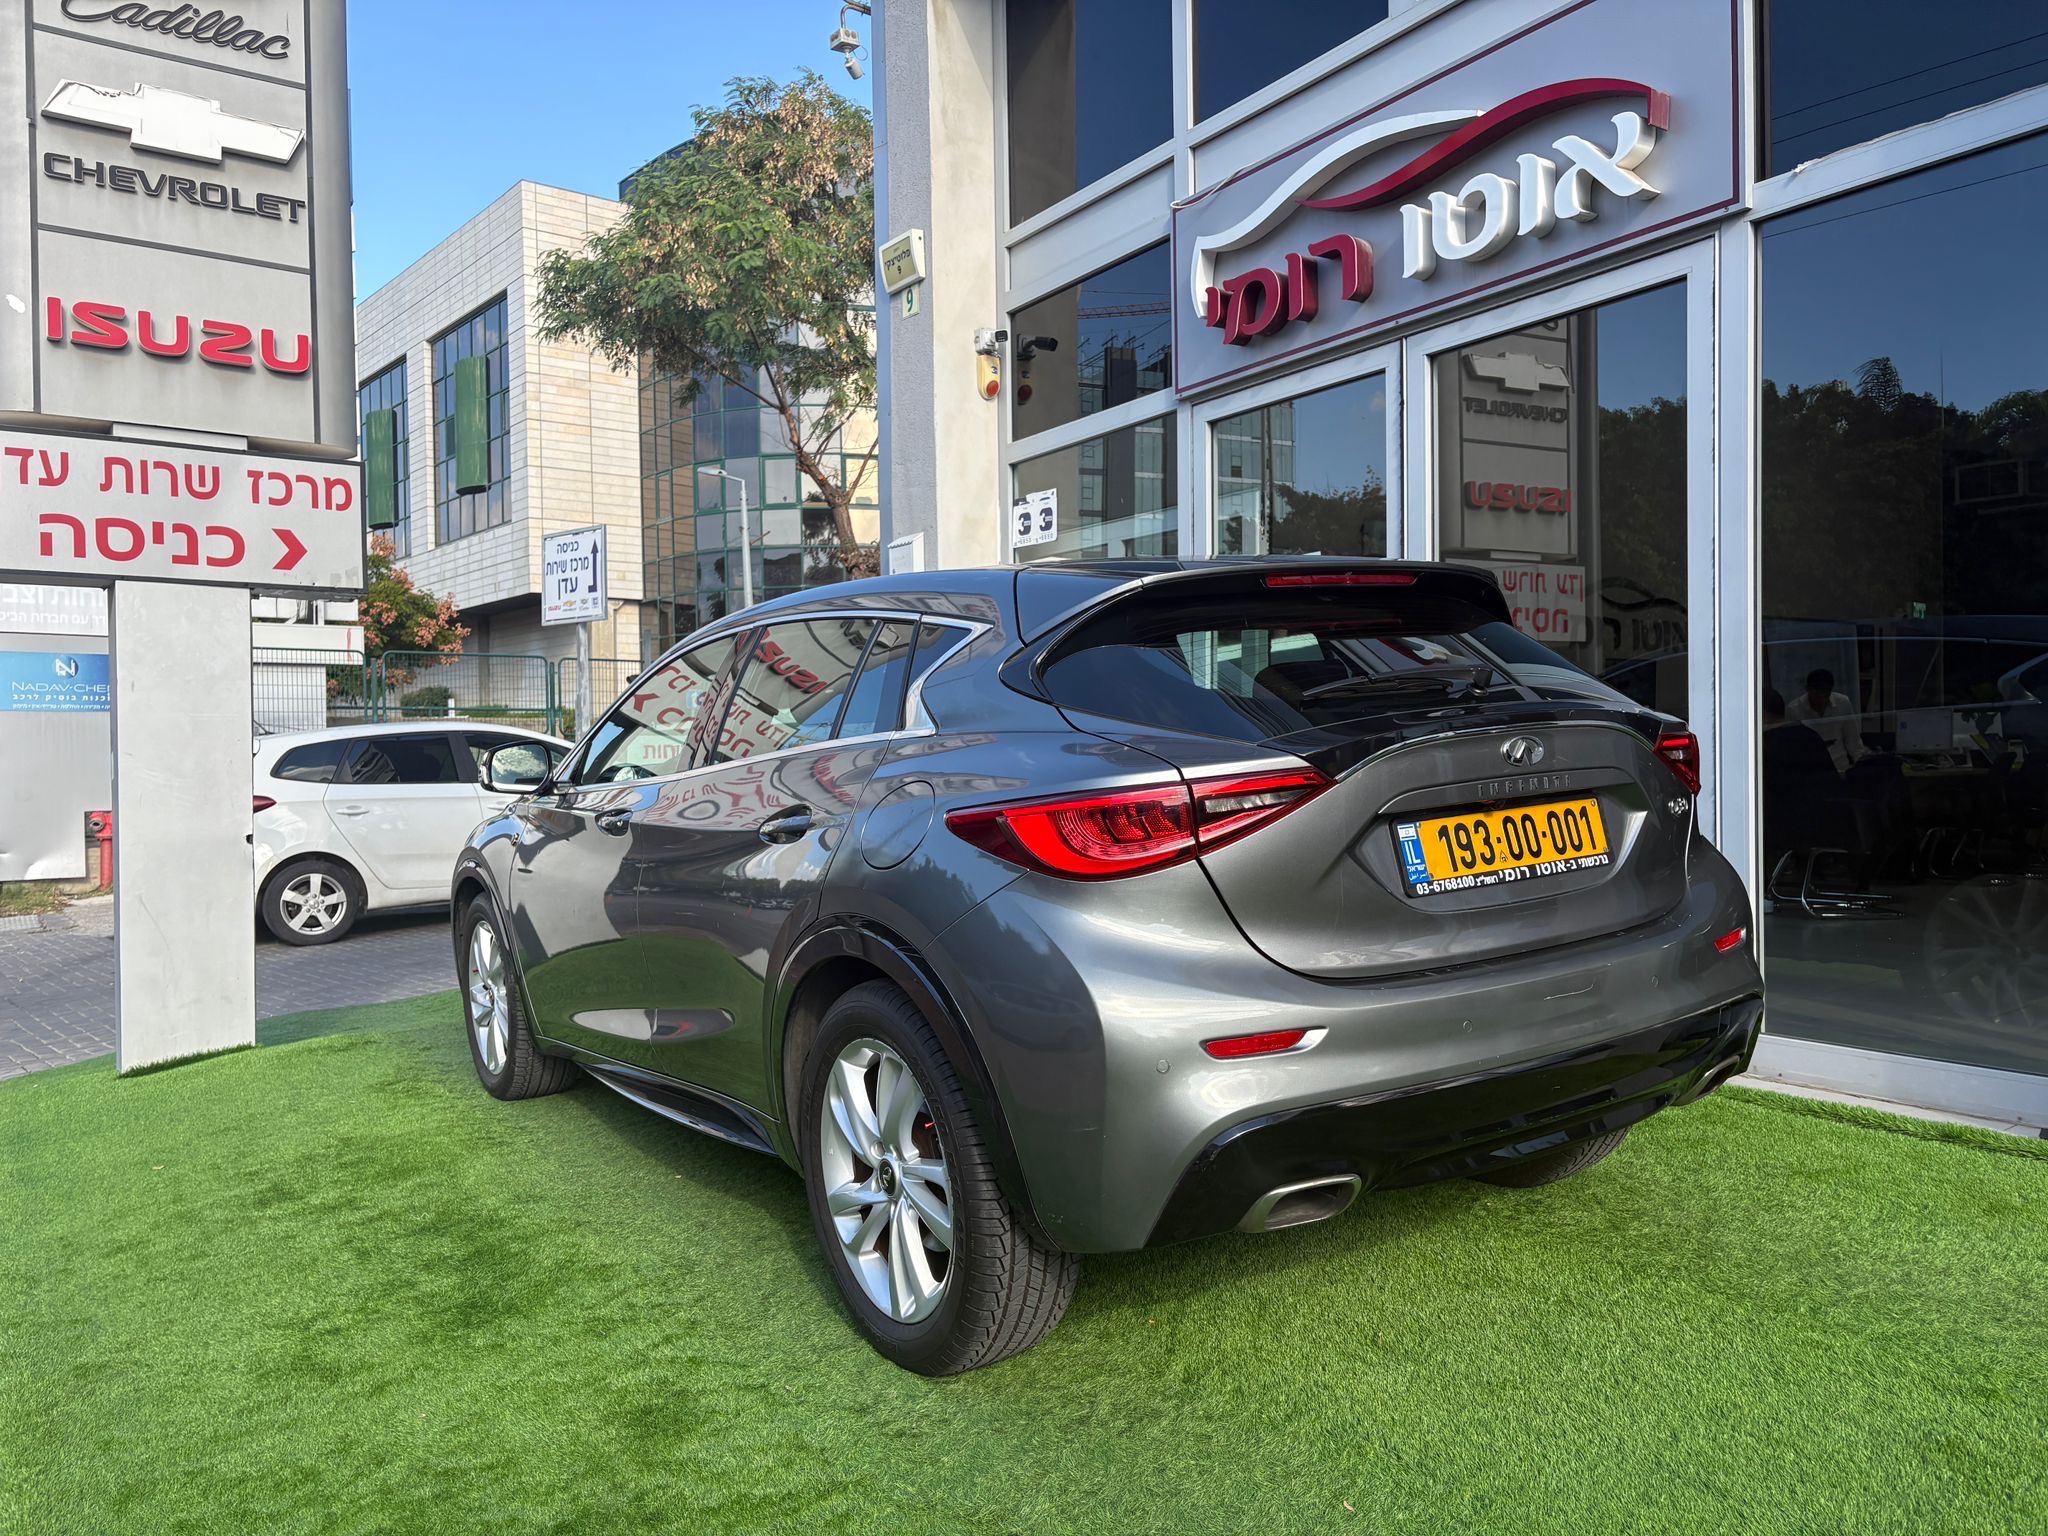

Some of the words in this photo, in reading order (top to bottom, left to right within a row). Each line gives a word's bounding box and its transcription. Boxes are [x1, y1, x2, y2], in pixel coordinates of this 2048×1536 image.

[43, 152, 306, 223] CHEVROLET
[1401, 111, 1661, 280] אוטו
[906, 287, 914, 312] 9
[1206, 233, 1374, 345] רומי
[46, 297, 311, 374] ISUZU
[4, 447, 69, 487] עד
[100, 456, 220, 501] שרות
[247, 470, 353, 511] מרכז
[39, 513, 246, 568] כניסה
[557, 541, 579, 554] כניסה
[570, 557, 589, 572] מרכז
[558, 577, 578, 600] עדן
[1404, 841, 1421, 865] IL
[1416, 875, 1475, 895] 03-6768100
[1498, 866, 1531, 883] רומי
